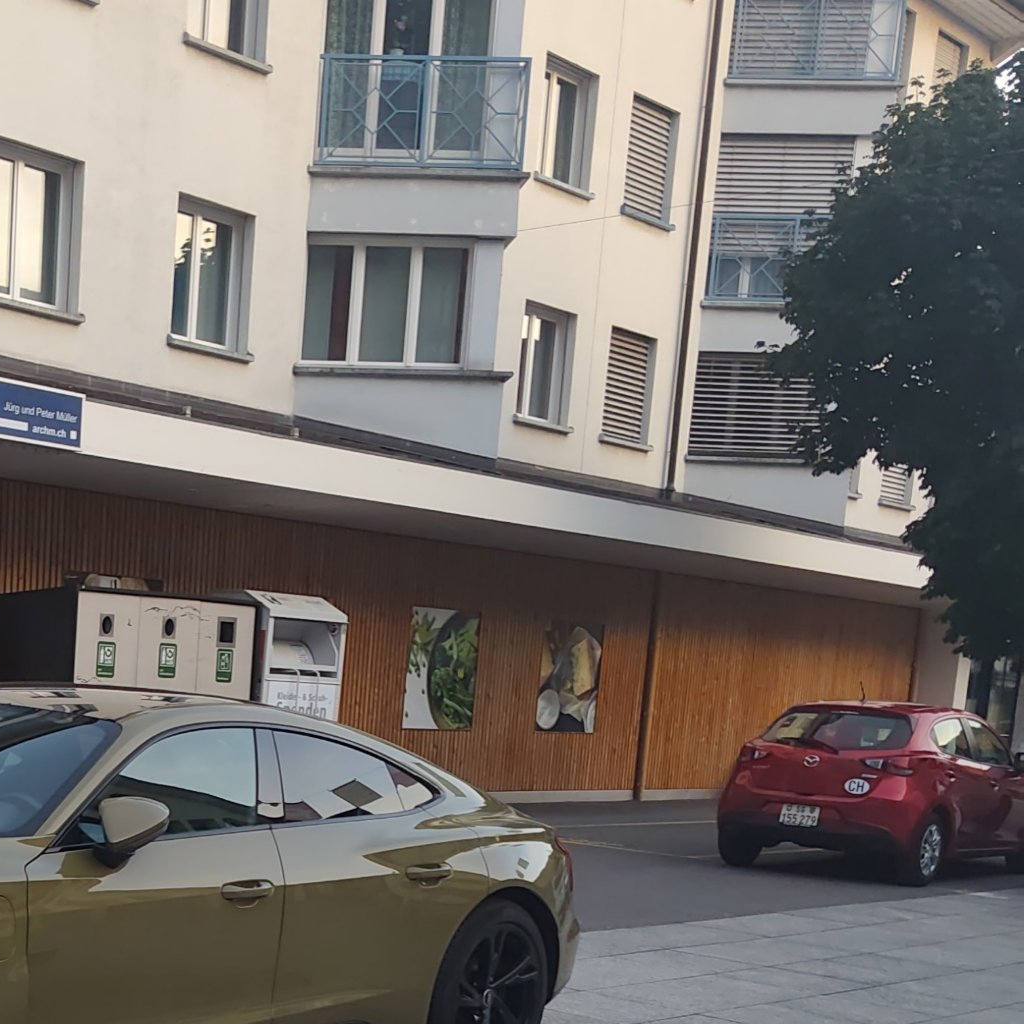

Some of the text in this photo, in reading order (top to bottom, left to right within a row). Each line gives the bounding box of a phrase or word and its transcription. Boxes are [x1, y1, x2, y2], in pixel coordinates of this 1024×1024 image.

[3, 401, 78, 423] Jürg und Peter Müller
[32, 425, 67, 438] archm.ch
[848, 780, 865, 792] CH
